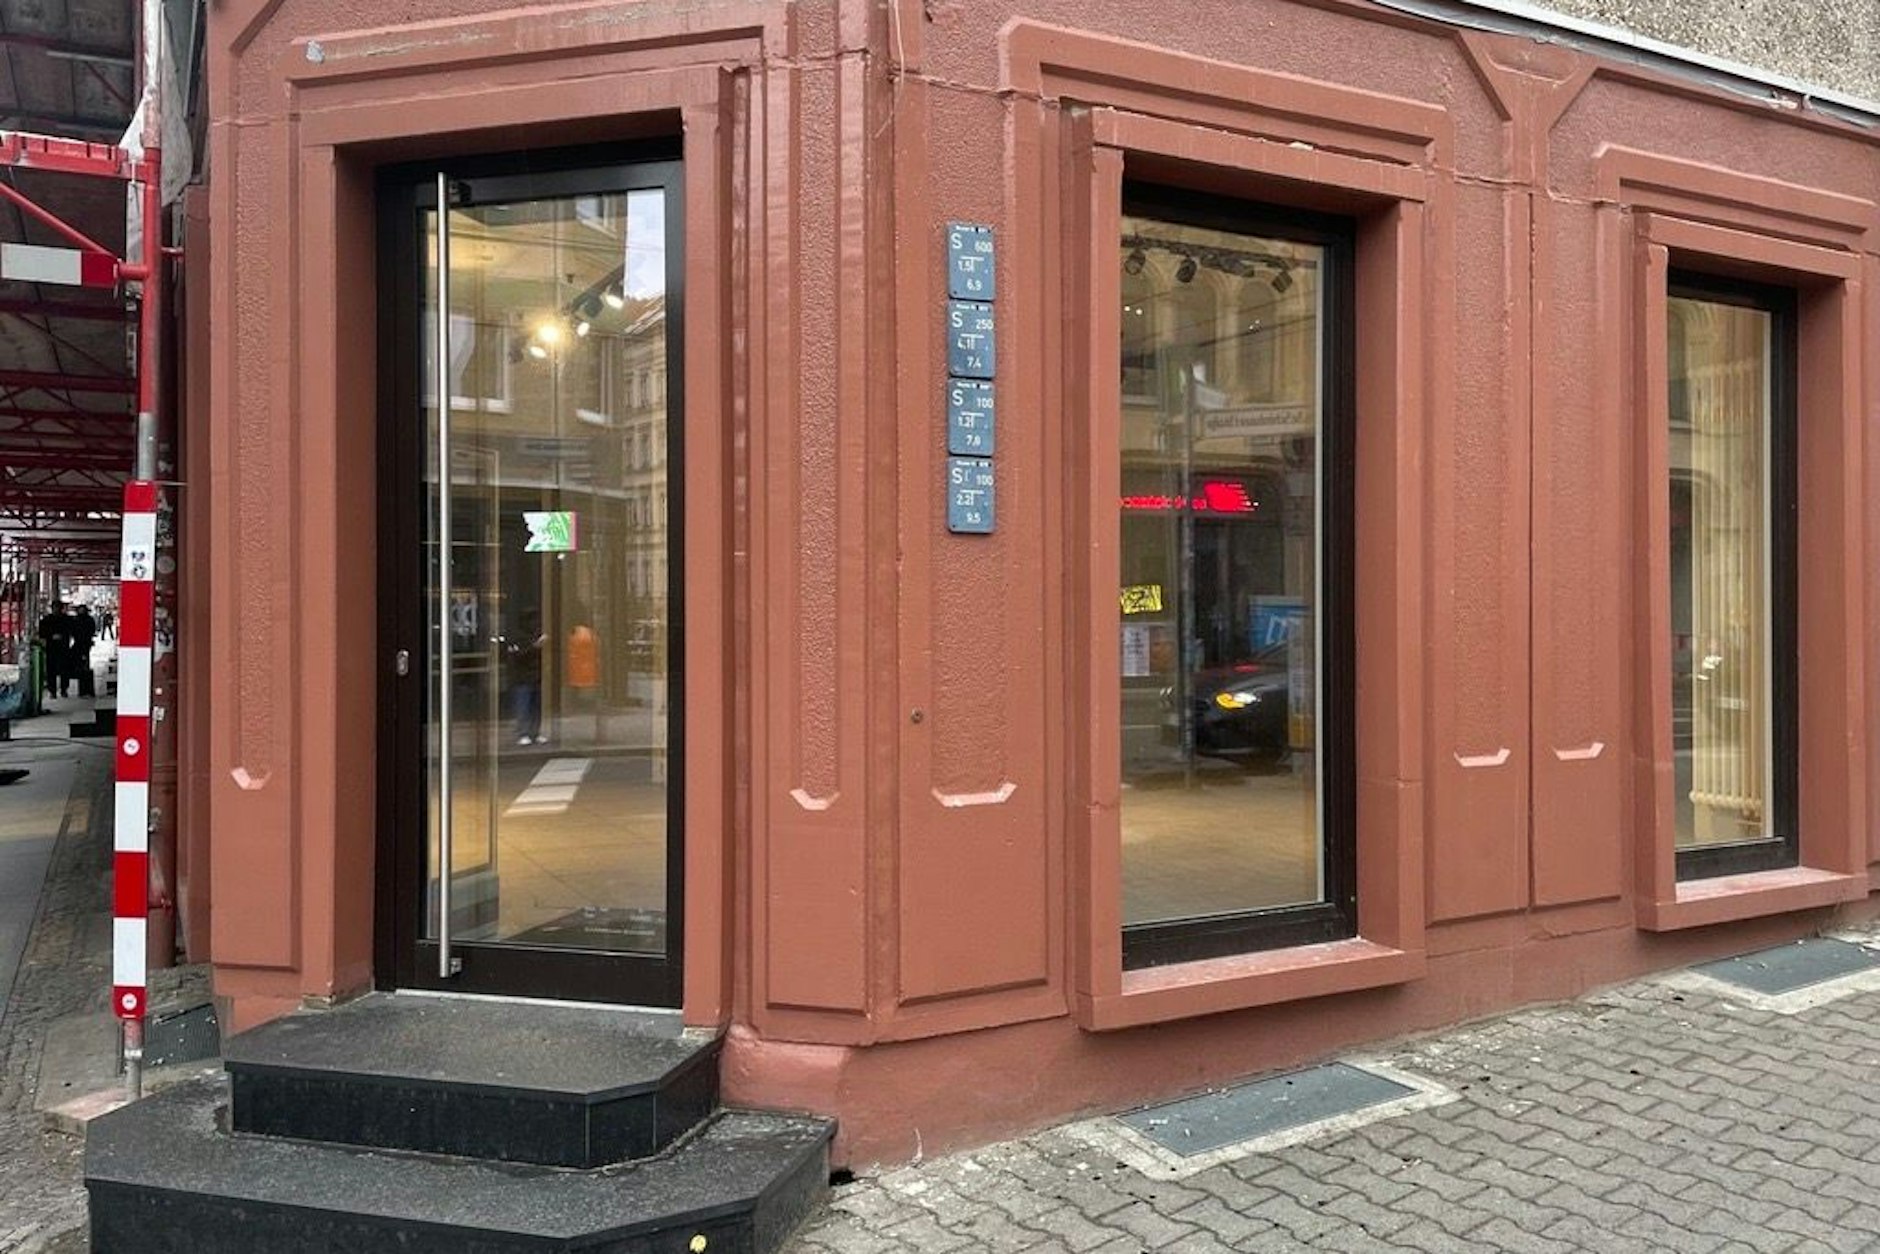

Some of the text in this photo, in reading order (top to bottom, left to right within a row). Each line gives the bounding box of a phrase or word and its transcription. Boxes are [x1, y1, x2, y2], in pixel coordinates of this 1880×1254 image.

[951, 233, 962, 249] S
[952, 312, 963, 328] S
[952, 389, 994, 409] S 100
[952, 467, 963, 484] S
